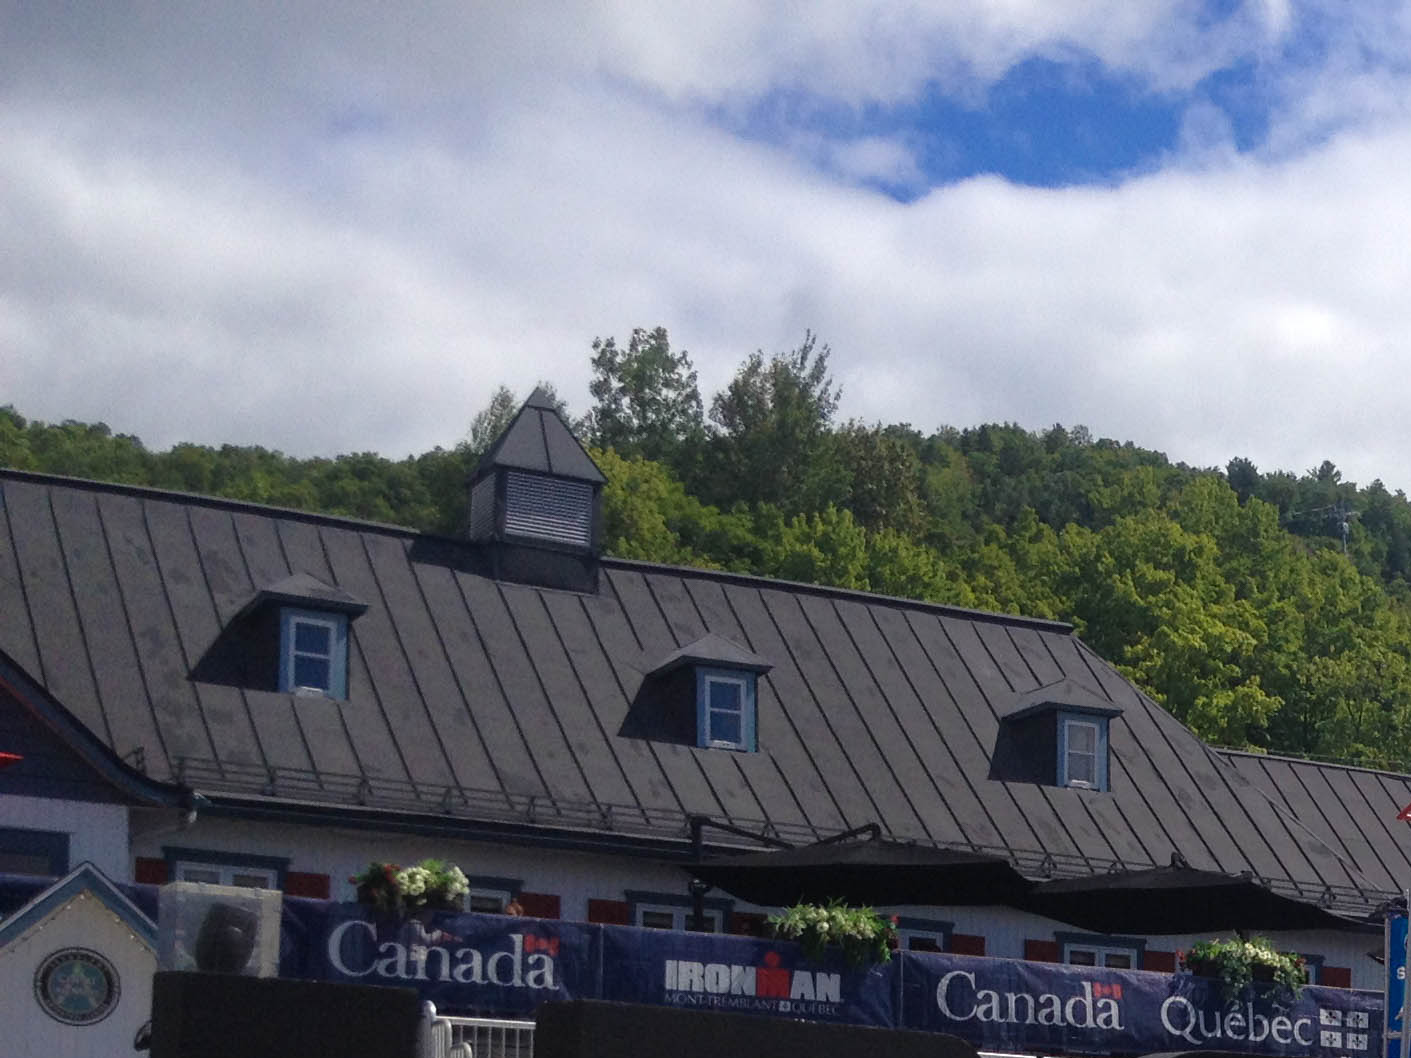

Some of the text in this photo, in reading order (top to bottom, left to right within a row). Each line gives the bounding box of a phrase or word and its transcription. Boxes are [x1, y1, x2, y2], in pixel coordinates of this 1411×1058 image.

[328, 919, 560, 990] Canada
[665, 952, 841, 1002] IRONMAN
[936, 970, 1124, 1030] Canada
[1160, 995, 1315, 1045] Québec
